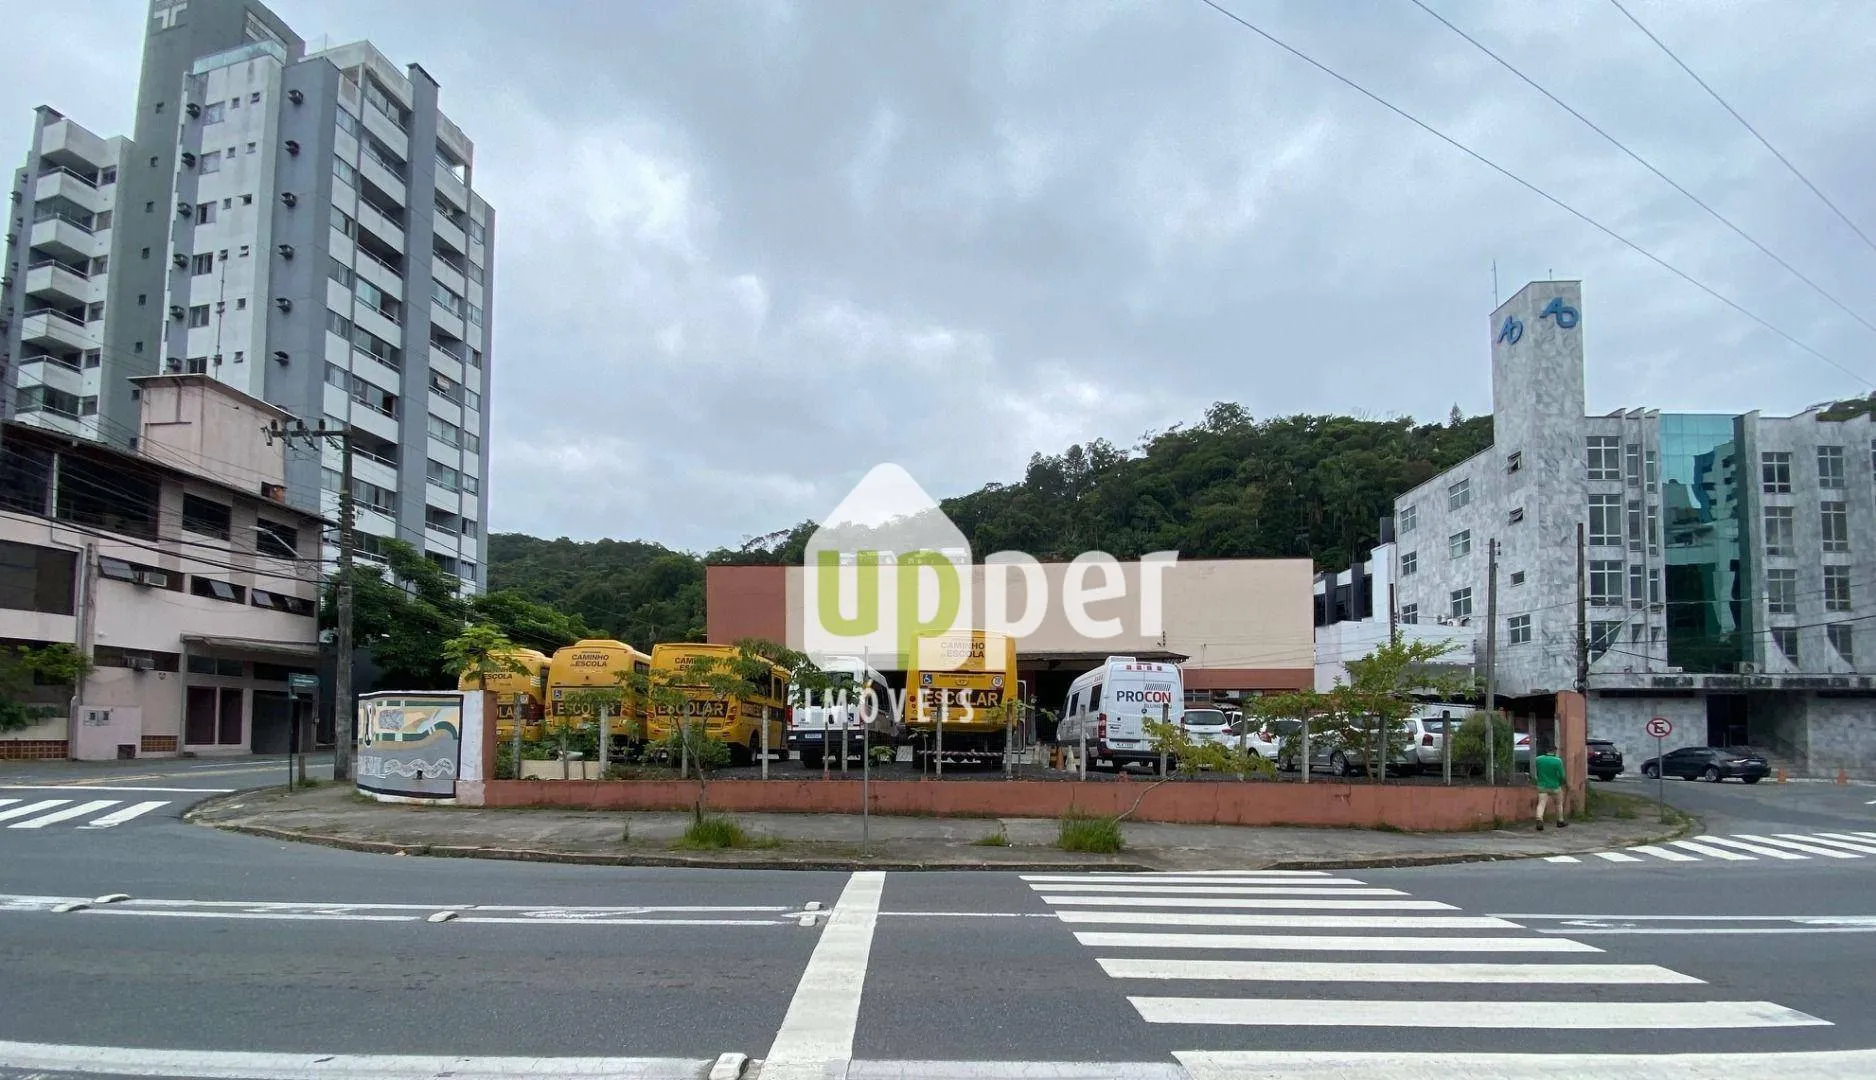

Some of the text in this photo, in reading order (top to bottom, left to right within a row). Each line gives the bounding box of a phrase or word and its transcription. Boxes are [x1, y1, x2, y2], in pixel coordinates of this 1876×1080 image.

[575, 660, 608, 668] ESCOLA
[925, 690, 999, 707] ESCOLAR
[1116, 690, 1172, 703] PROCON
